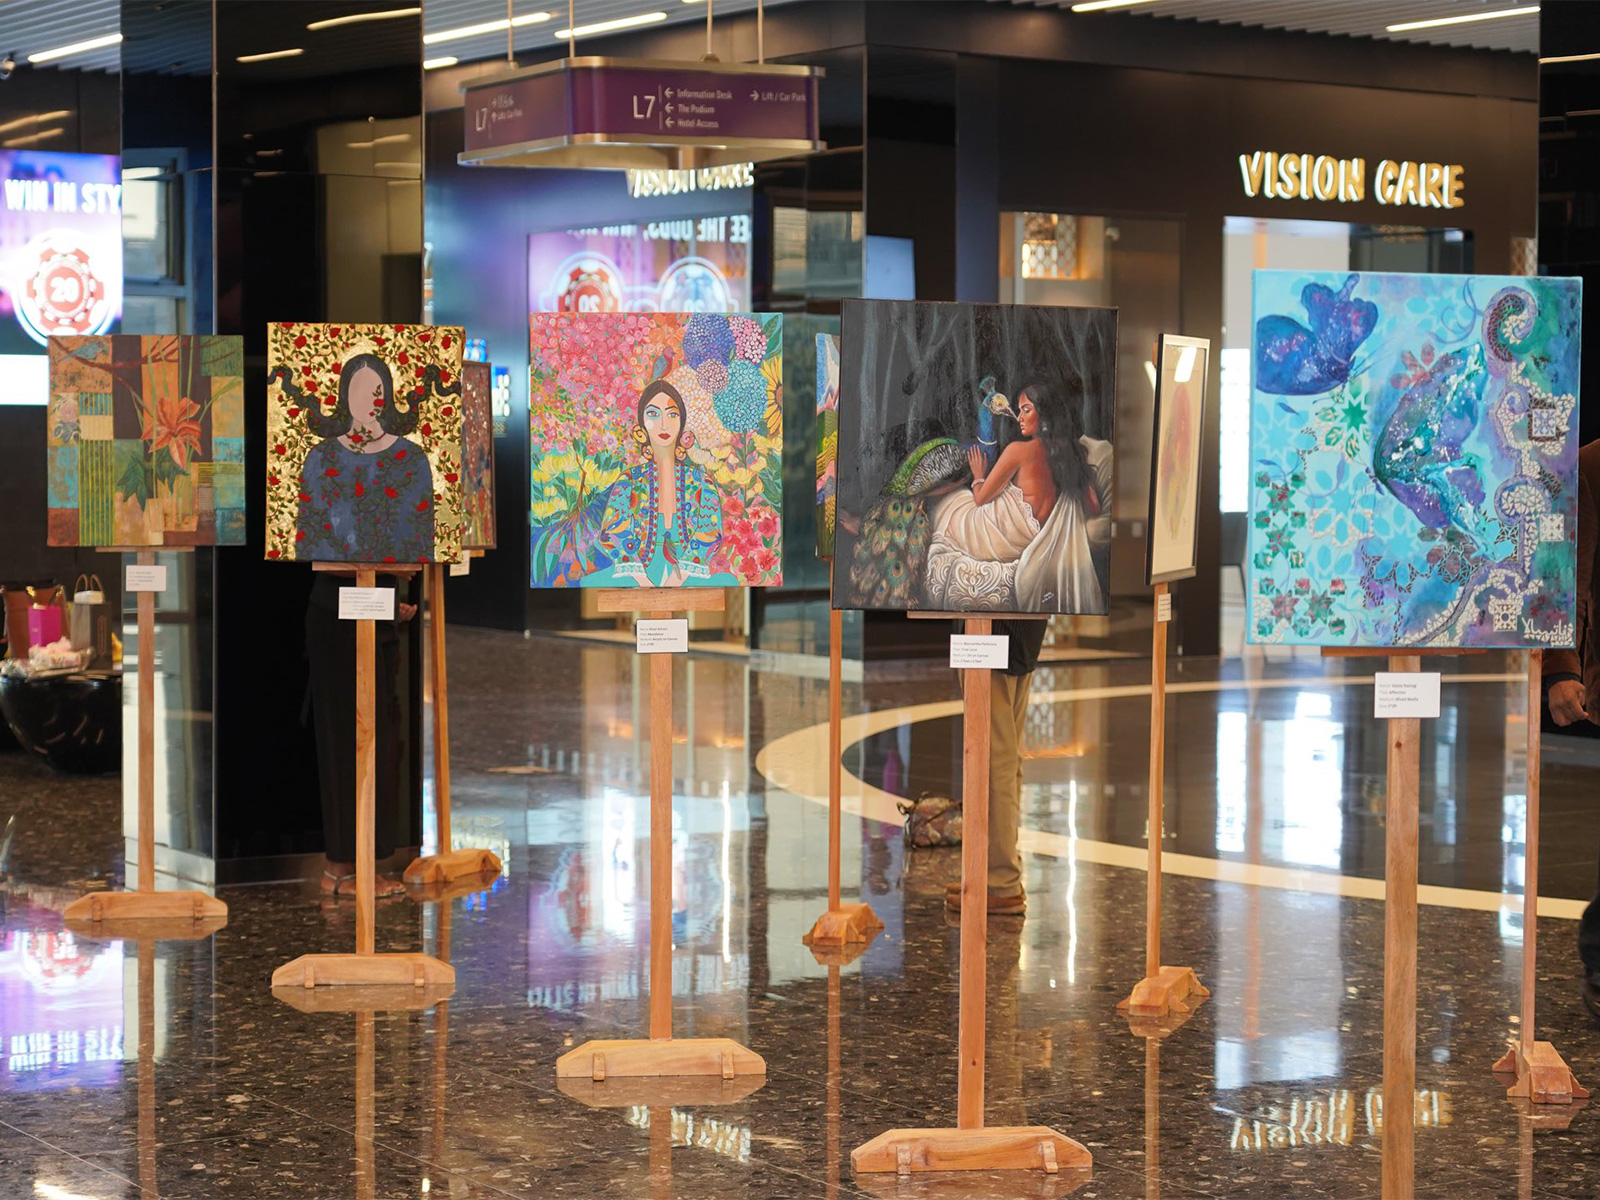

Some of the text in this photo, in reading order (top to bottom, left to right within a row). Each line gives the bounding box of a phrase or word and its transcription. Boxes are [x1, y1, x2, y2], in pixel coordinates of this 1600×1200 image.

[632, 94, 656, 119] L7
[677, 89, 732, 99] Information Desk
[1239, 151, 1465, 209] VISION CARE
[4, 178, 50, 212] WIN
[53, 181, 77, 213] IN
[50, 276, 80, 303] 20
